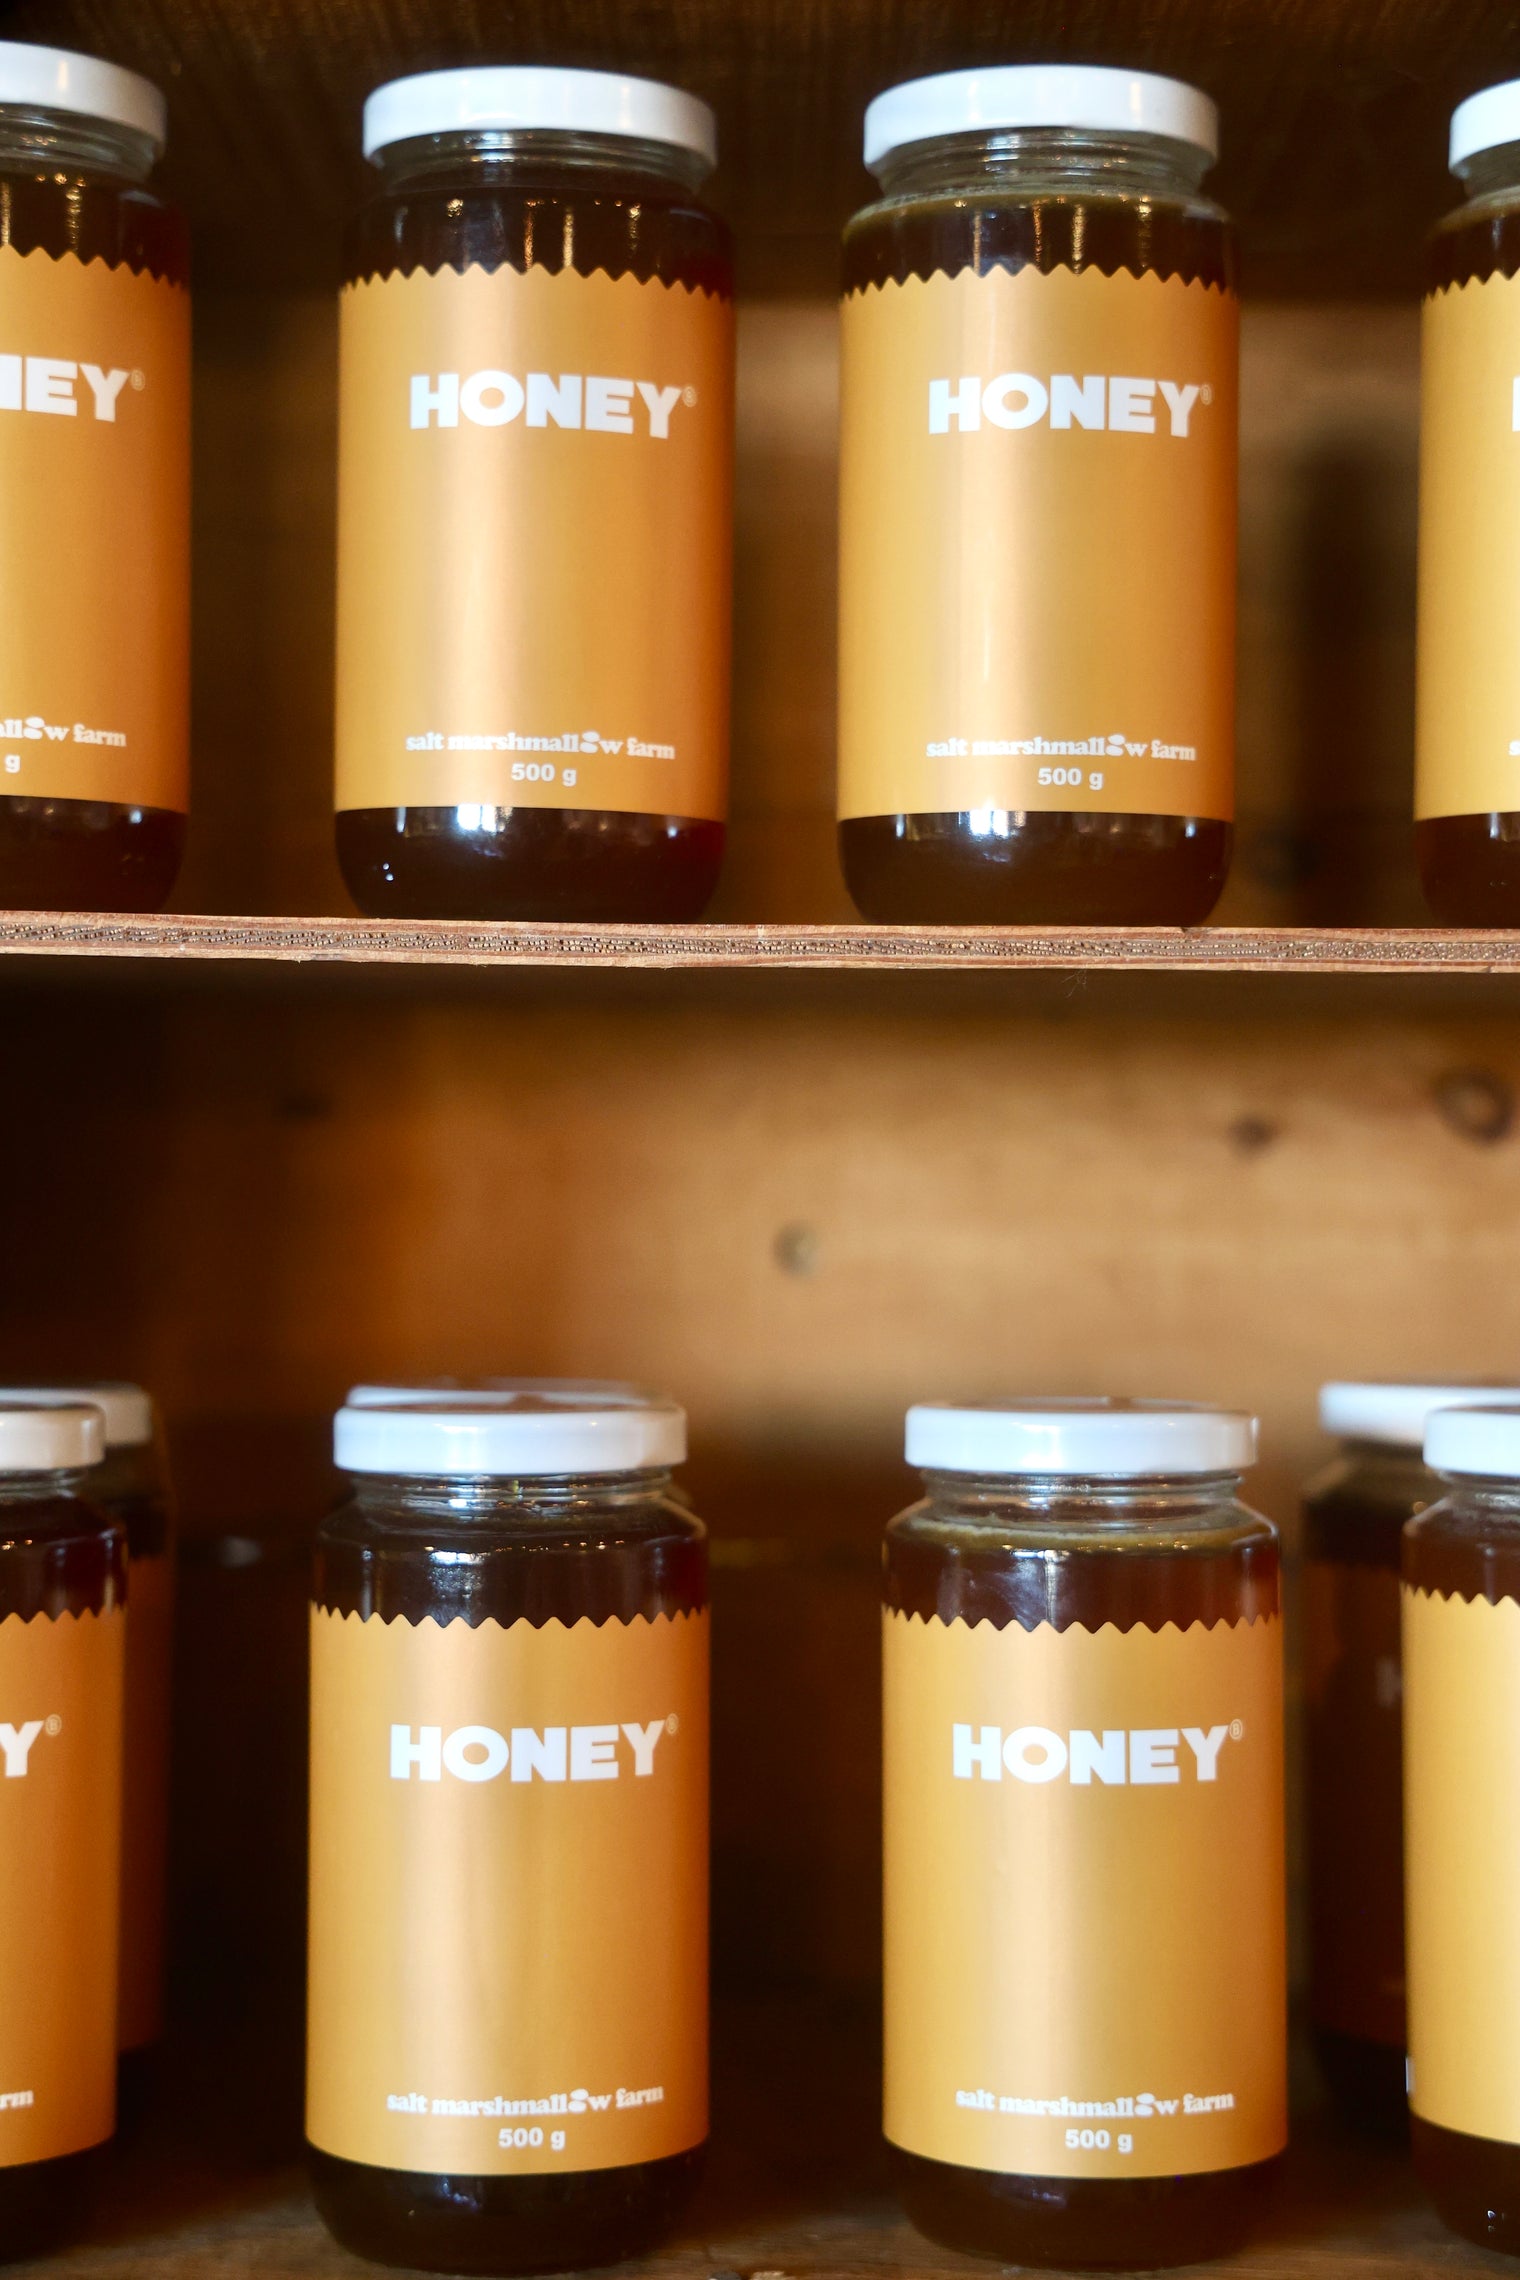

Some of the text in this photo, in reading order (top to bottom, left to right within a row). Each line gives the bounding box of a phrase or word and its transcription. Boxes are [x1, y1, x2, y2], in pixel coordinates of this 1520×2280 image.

[73, 723, 126, 747] farm
[405, 731, 444, 751] salt
[626, 737, 676, 760] farm
[926, 738, 967, 757] salt
[1150, 739, 1197, 761] farm
[4, 754, 21, 774] g
[511, 763, 577, 787] 500 g
[1037, 767, 1104, 791] 500 g
[386, 2093, 428, 2113] salt
[615, 2084, 664, 2110] farm
[955, 2089, 996, 2110] salt
[1182, 2091, 1235, 2114] farm
[498, 2127, 566, 2153] 500 g
[1065, 2129, 1133, 2155] 500 g
